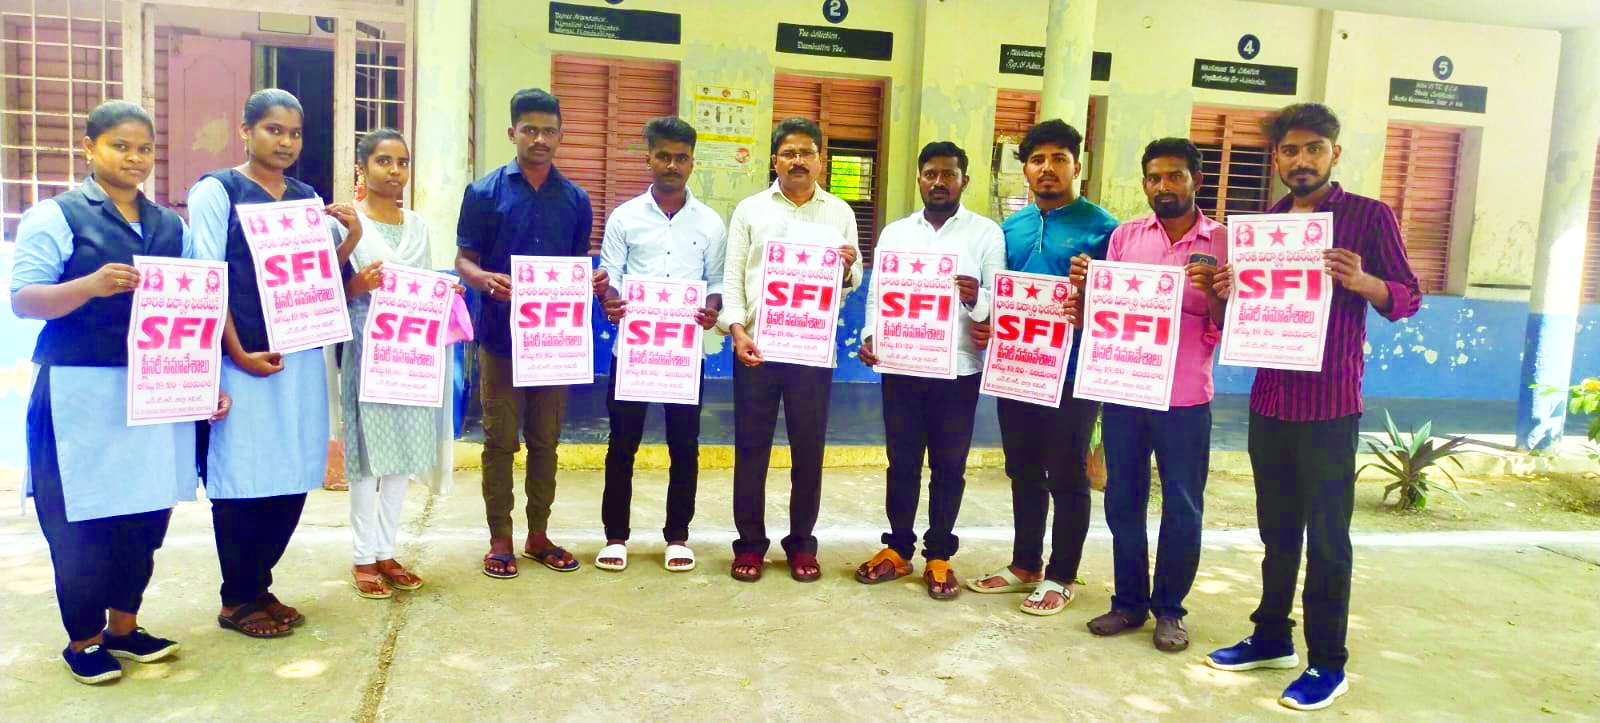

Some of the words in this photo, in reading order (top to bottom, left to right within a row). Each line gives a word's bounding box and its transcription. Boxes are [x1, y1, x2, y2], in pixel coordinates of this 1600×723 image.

[829, 0, 841, 16] 2
[1243, 39, 1255, 54] 4
[1438, 61, 1449, 75] 5
[265, 249, 333, 288] SFI
[766, 281, 833, 311] SFI
[1238, 269, 1321, 301] SFI
[518, 302, 585, 328] SFI
[881, 292, 951, 321] SFI
[137, 316, 218, 350] SFI
[371, 313, 440, 346] SFI
[626, 320, 696, 349] SFI
[997, 314, 1066, 349] SFI
[1092, 311, 1171, 345] SFI
